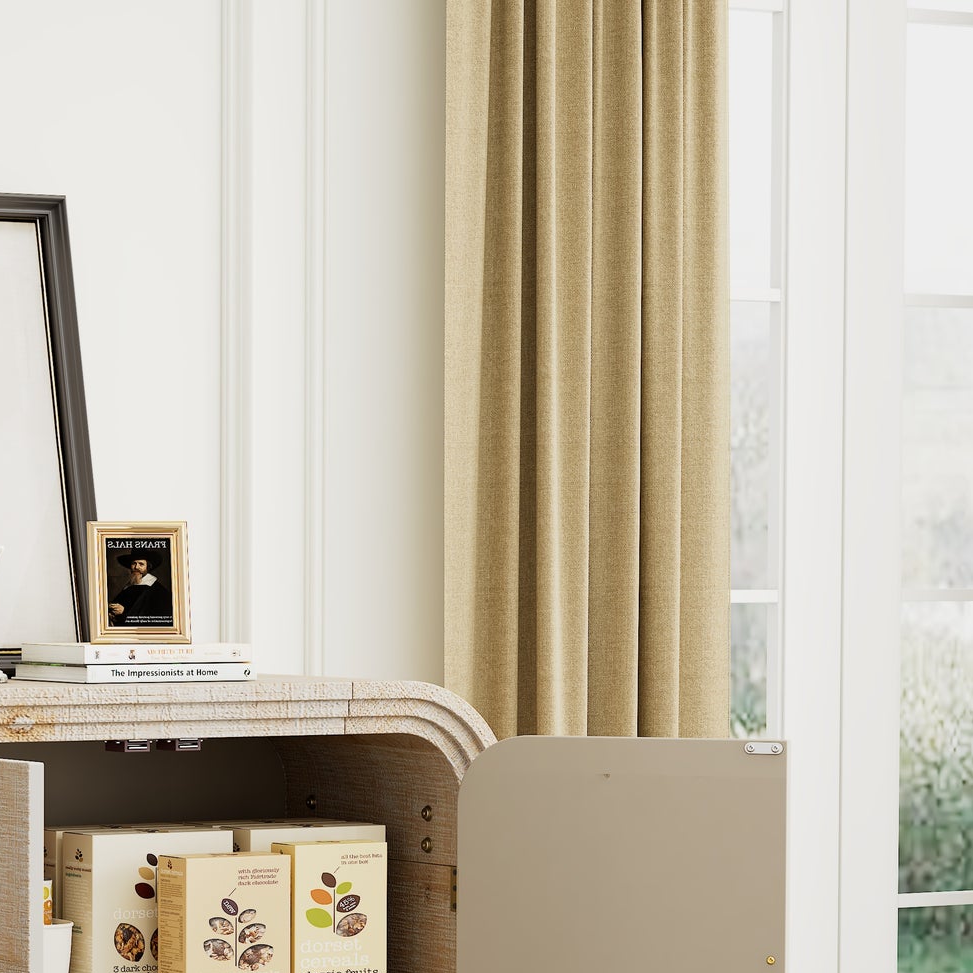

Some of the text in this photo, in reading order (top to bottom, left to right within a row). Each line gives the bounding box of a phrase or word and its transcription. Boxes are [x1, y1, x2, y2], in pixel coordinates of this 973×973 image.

[111, 669, 125, 677] The
[128, 669, 184, 679] Impressionists
[301, 938, 363, 953] dorset
[301, 952, 370, 969] cereals
[113, 965, 120, 973] 3
[121, 965, 140, 973] dark
